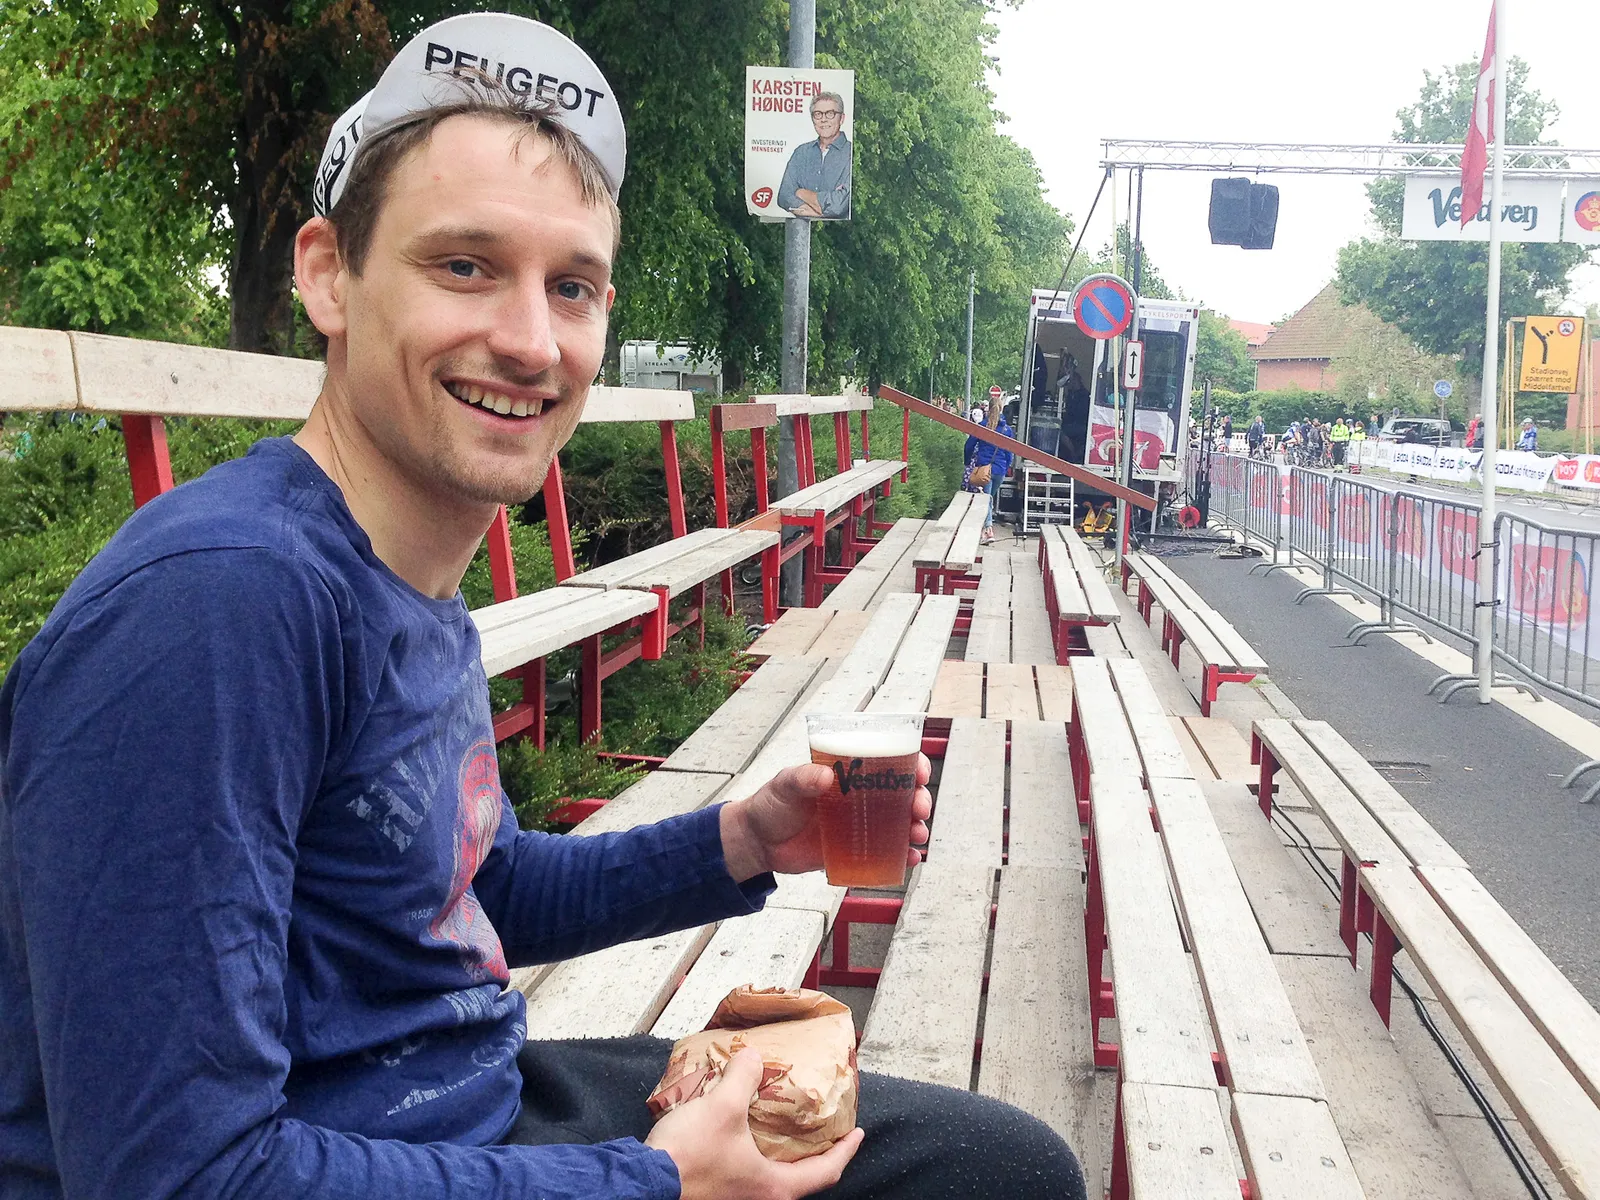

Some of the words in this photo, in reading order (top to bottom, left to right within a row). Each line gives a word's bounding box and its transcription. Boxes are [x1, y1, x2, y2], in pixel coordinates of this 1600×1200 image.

[424, 42, 604, 117] PEUGEOT
[752, 79, 822, 97] KARSTEN
[752, 97, 804, 113] HØNGE
[751, 139, 784, 147] INVESTERING
[755, 191, 770, 203] SF
[1143, 310, 1188, 319] CYKELSPORT
[1530, 366, 1568, 376] Stadionvej
